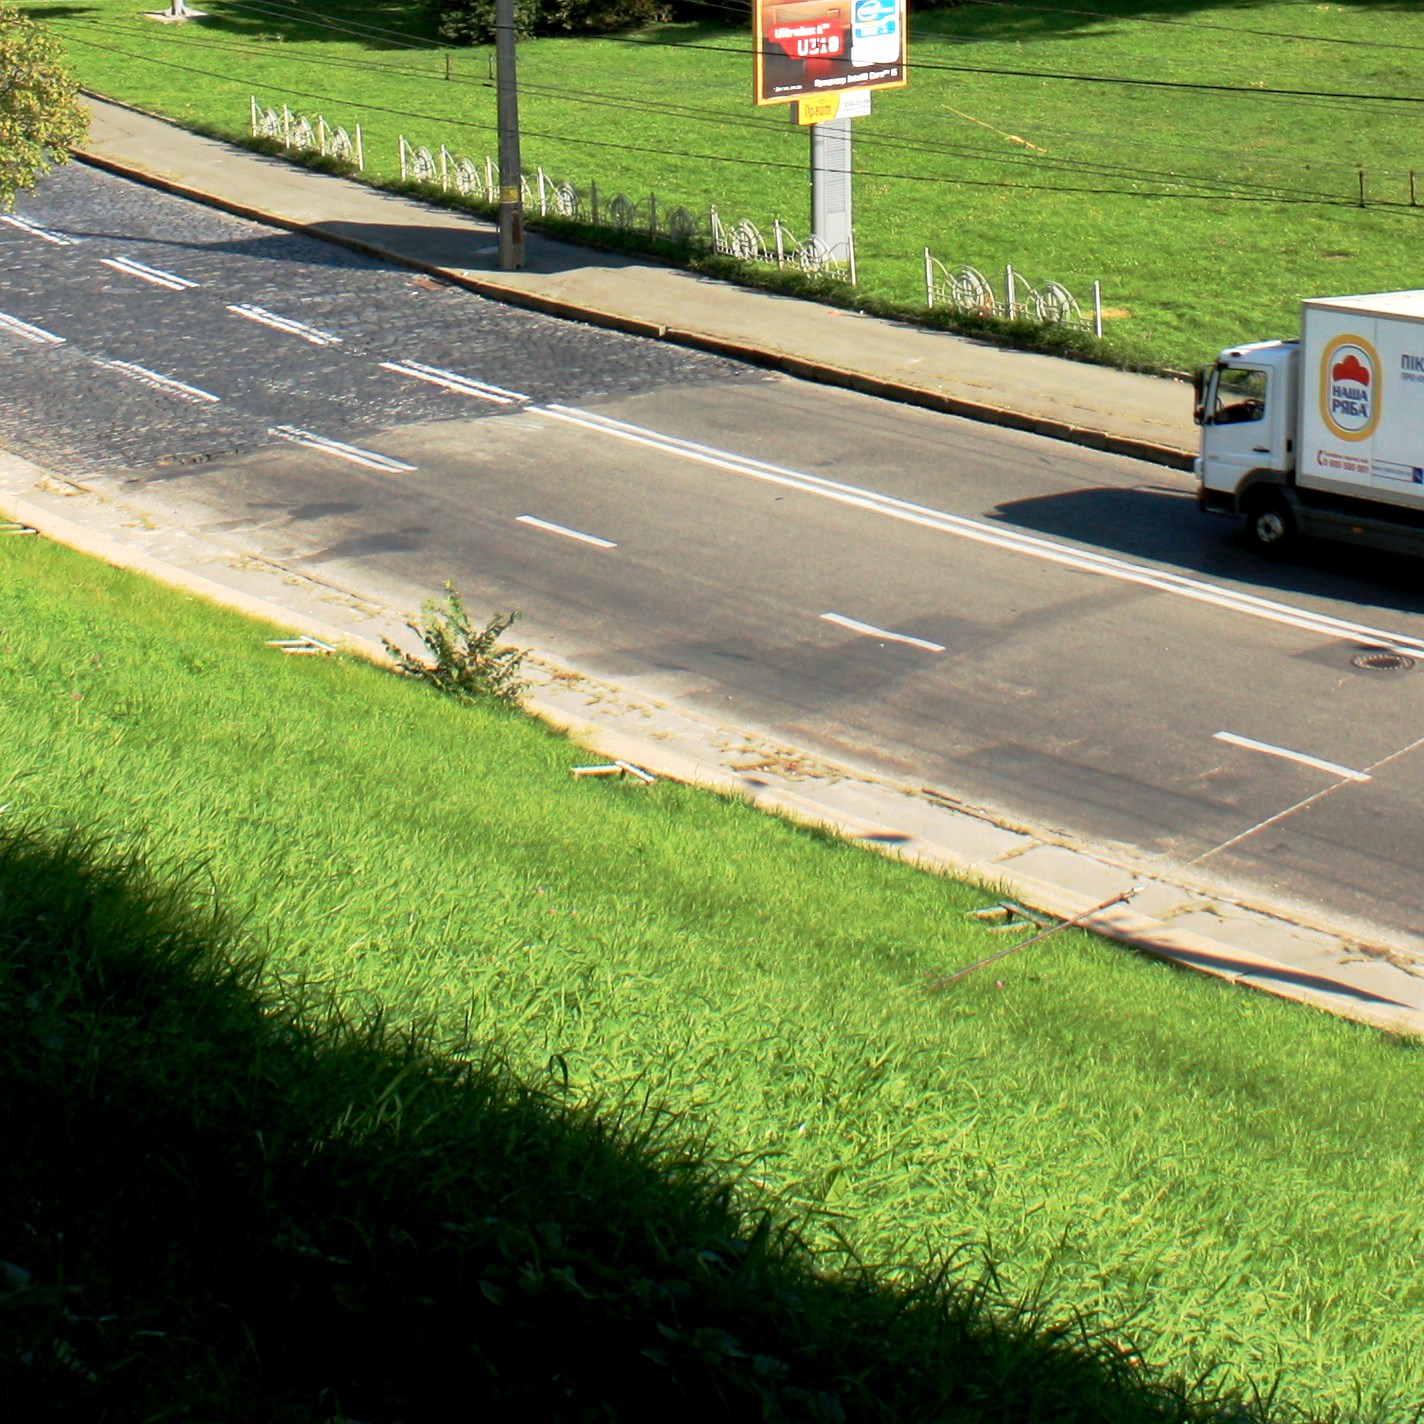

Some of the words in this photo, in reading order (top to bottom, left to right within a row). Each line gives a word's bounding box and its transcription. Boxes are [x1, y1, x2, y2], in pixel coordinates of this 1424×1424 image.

[797, 36, 839, 56] U310
[1333, 386, 1368, 401] НАША
[1333, 400, 1368, 418] РЯБА
